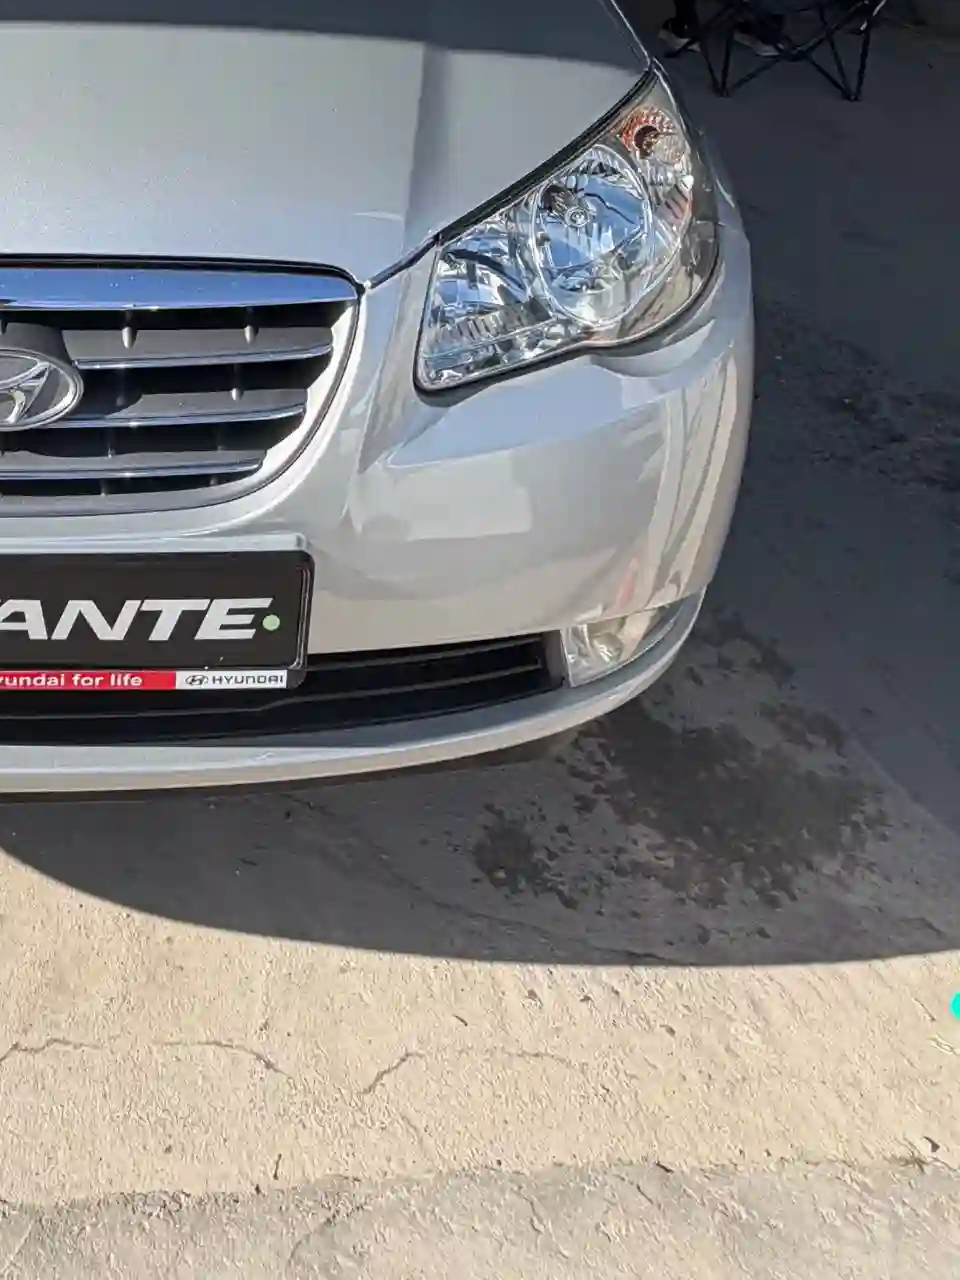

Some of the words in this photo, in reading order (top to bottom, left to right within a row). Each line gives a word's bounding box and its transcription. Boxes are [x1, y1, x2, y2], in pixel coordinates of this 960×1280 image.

[72, 673, 105, 686] for
[110, 673, 143, 686] life
[212, 675, 284, 685] HYUNDAI
